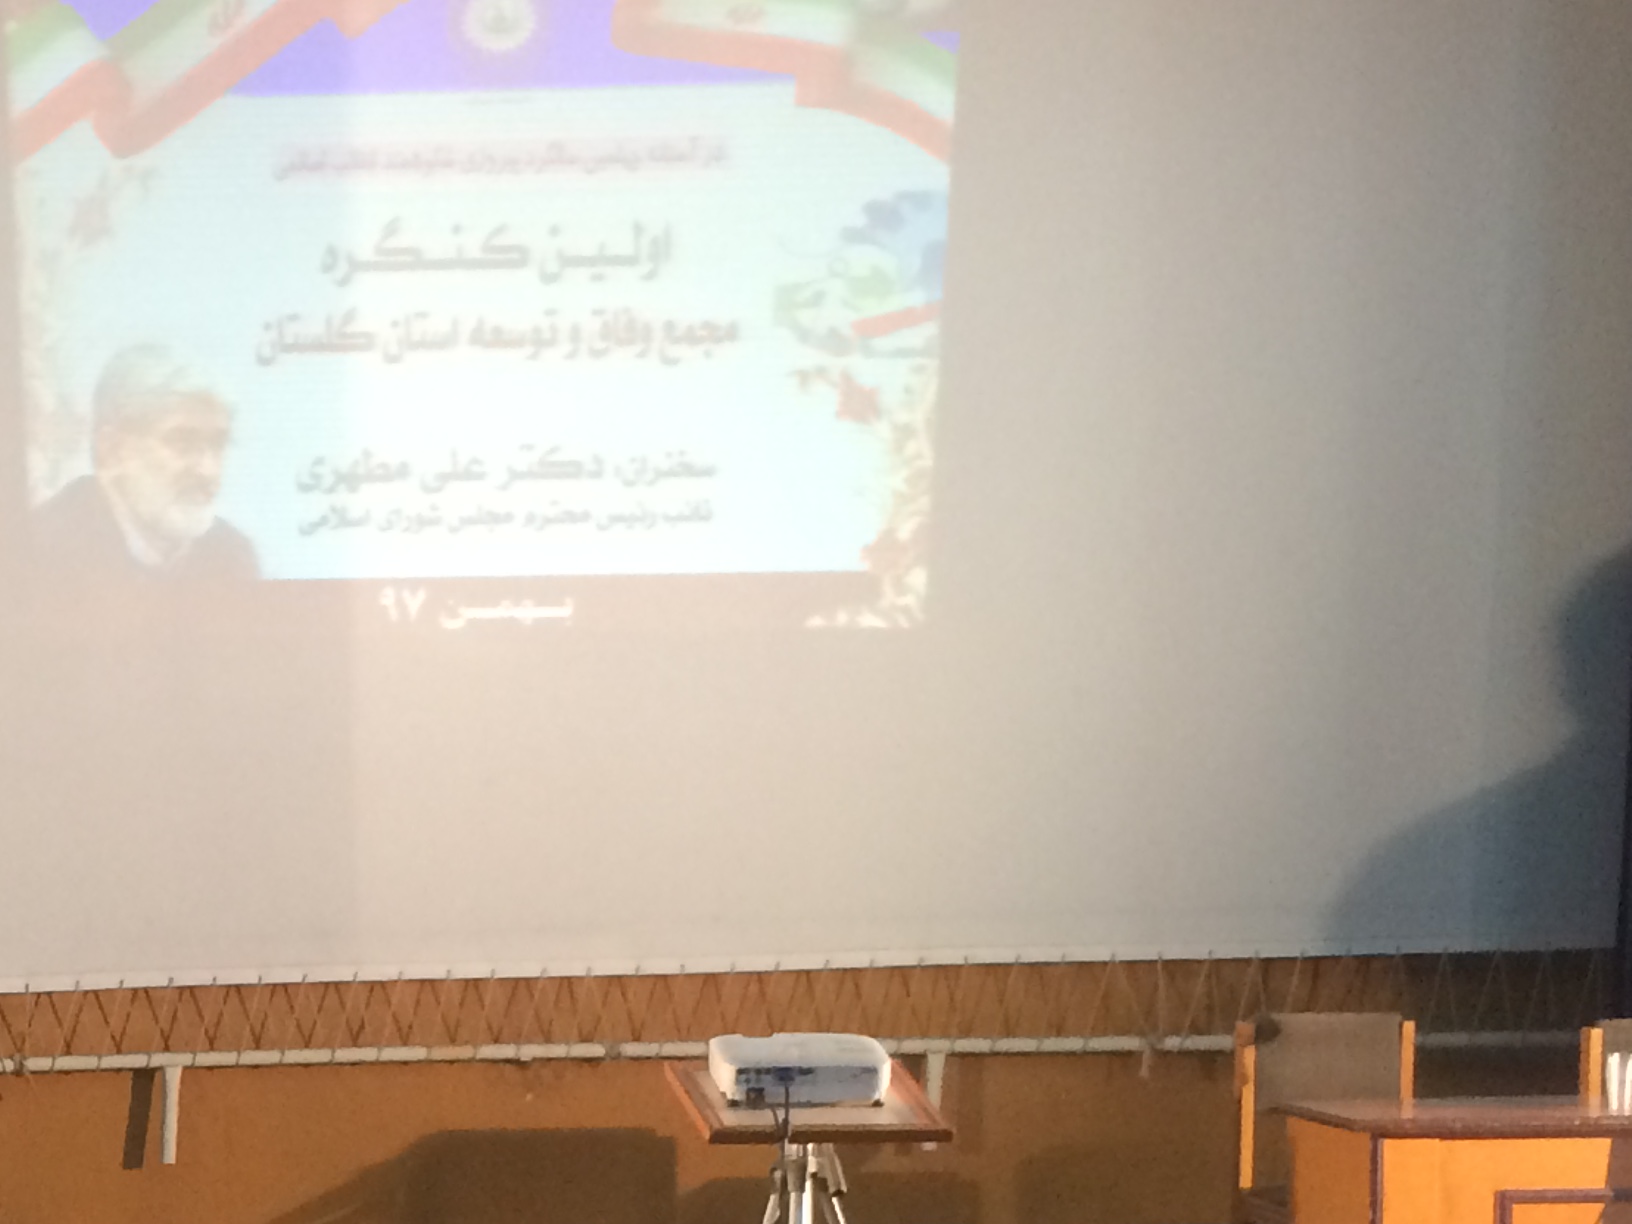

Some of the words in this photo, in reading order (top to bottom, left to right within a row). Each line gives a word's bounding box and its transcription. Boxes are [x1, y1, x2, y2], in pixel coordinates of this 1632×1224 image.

[320, 214, 532, 288] کنگره
[538, 219, 672, 286] اولین
[382, 310, 461, 365] استان
[588, 307, 654, 359] وفاق
[658, 319, 739, 366] مجمع
